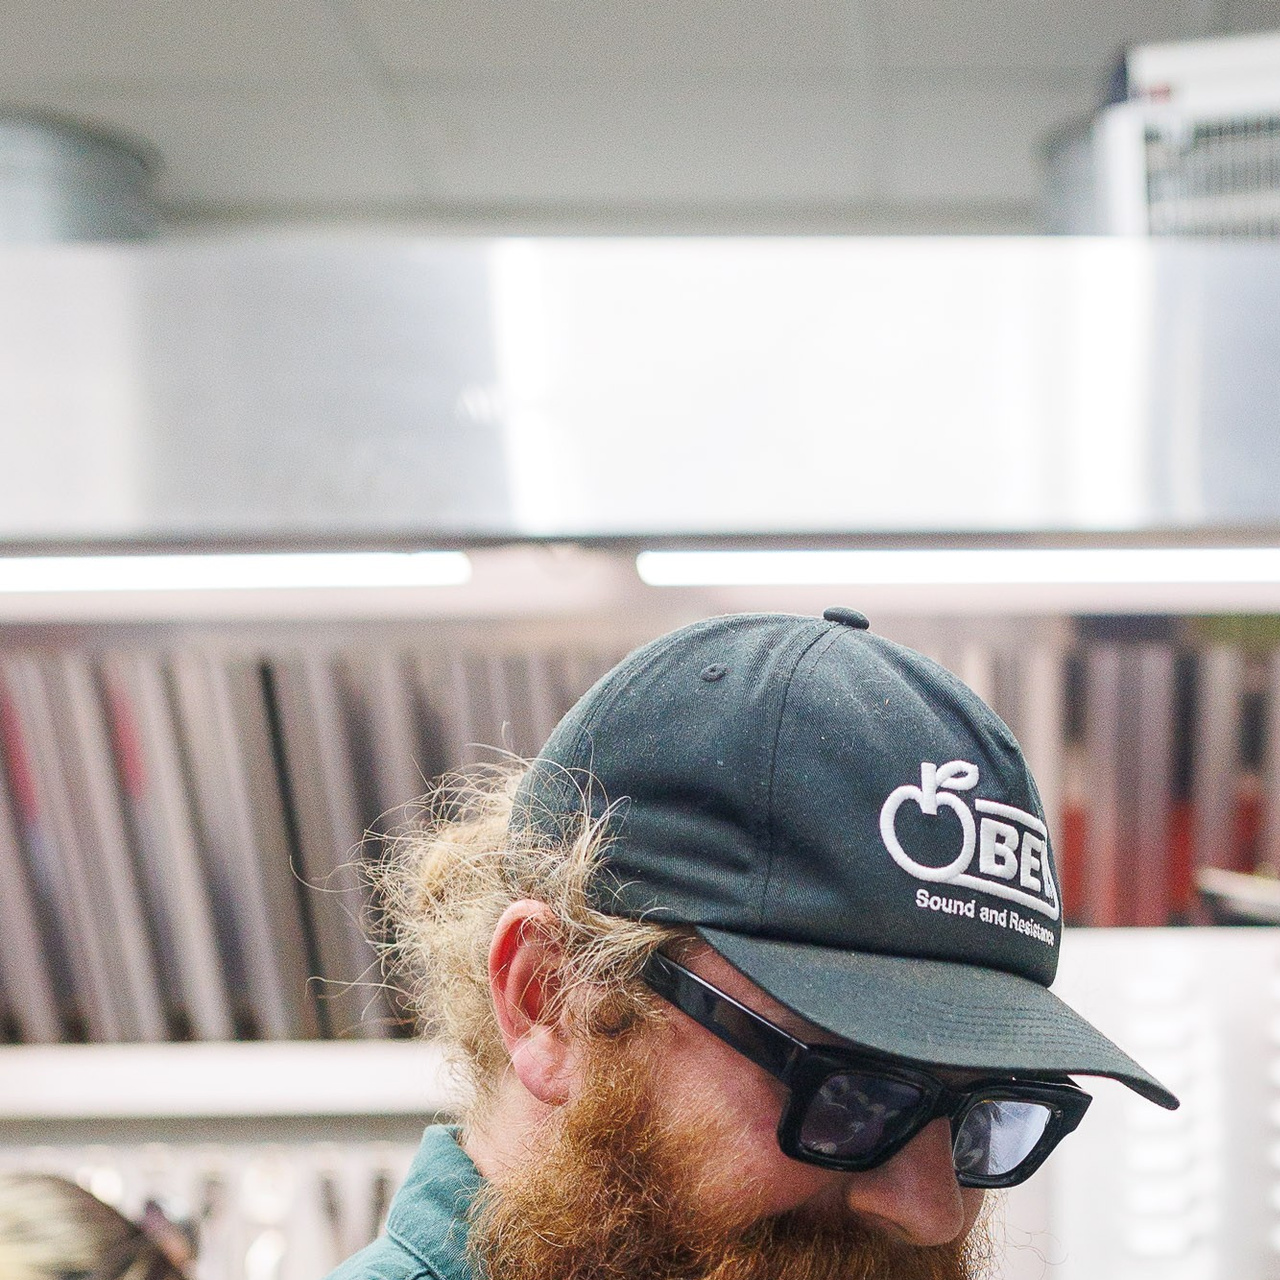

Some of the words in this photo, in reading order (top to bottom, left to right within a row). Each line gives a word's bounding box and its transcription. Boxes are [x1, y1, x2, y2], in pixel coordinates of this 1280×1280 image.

[915, 888, 975, 919] Sound
[979, 905, 1007, 928] and
[1009, 911, 1055, 947] Resistance
